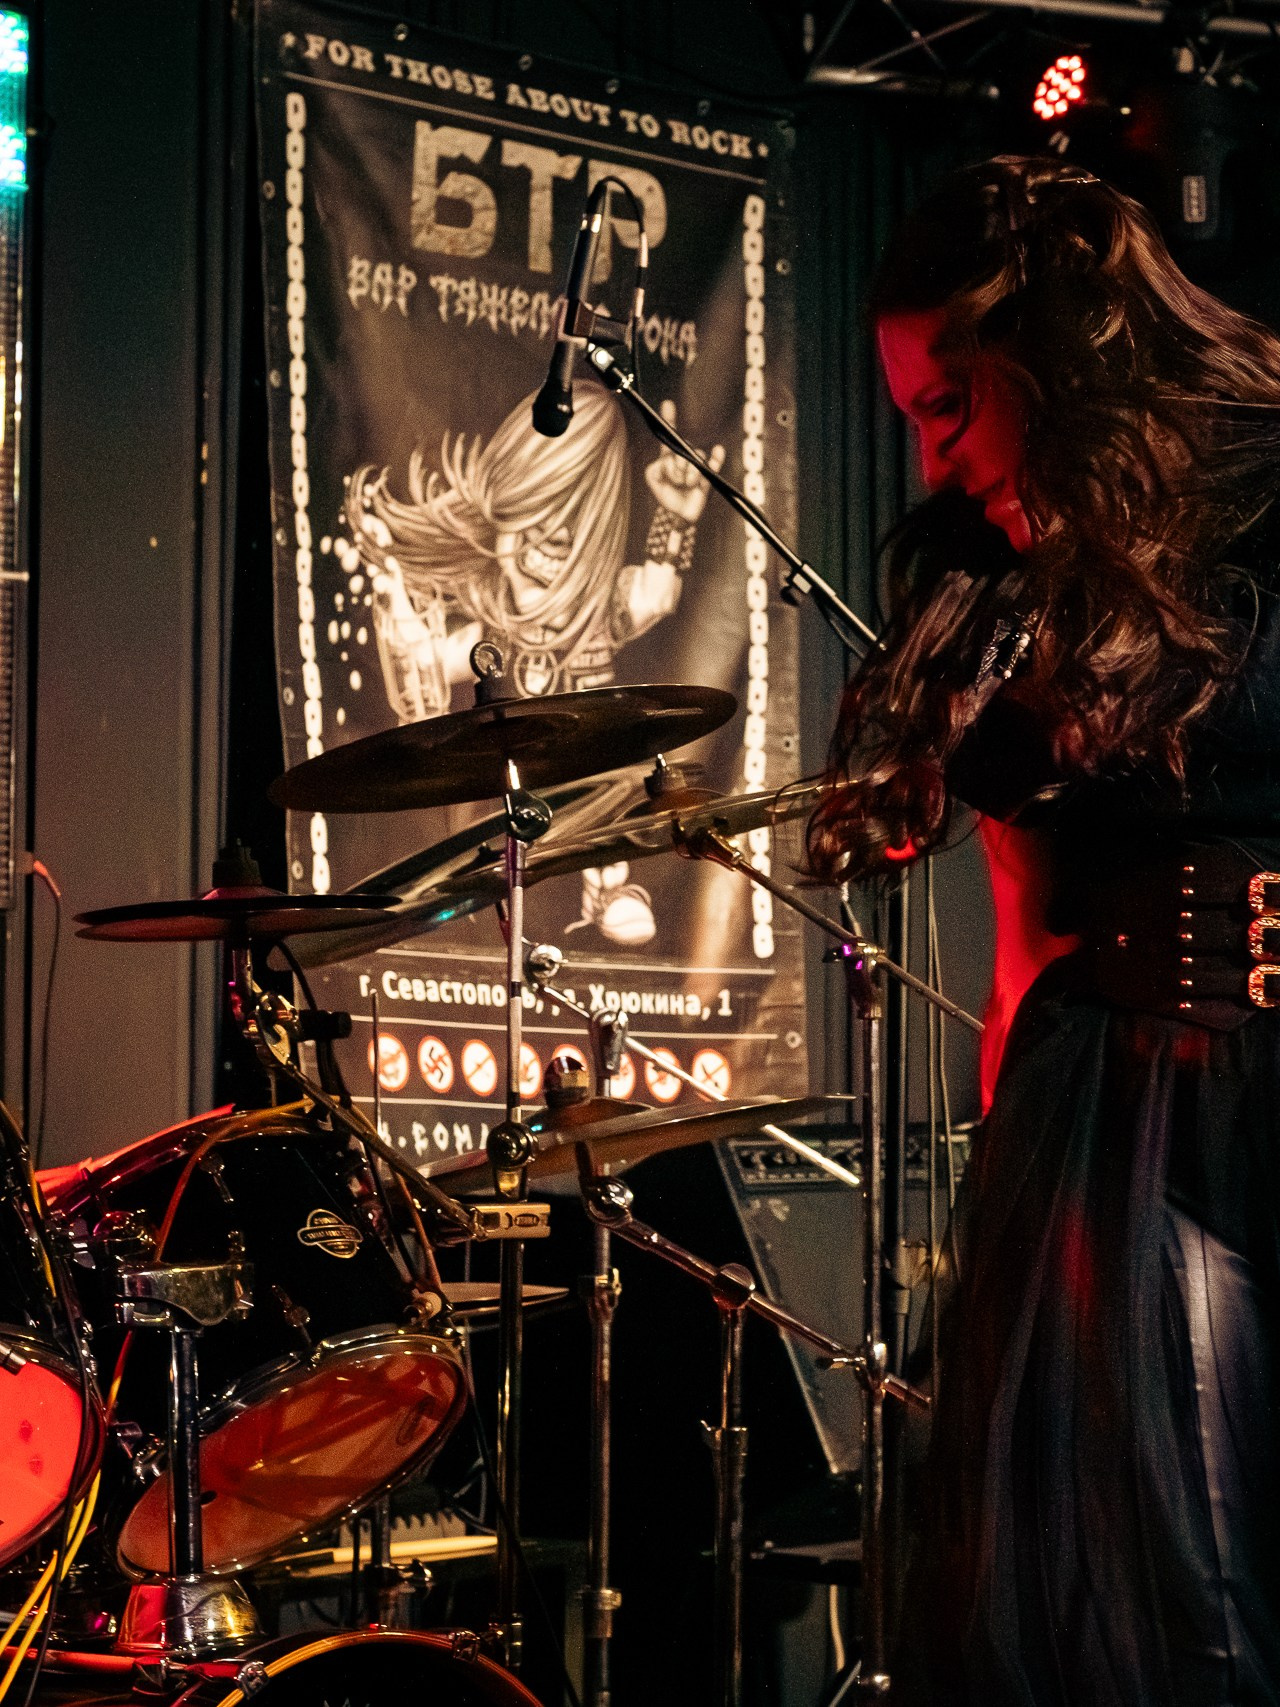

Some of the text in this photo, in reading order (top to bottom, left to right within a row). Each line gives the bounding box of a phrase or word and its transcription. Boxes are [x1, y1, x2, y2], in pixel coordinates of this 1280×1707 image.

[303, 33, 752, 159] FOR THOSE ABOUT TO ROCK
[410, 119, 667, 285] БТР
[381, 970, 545, 1015] Севастопоь,
[589, 983, 711, 1022] Хрюкина,
[717, 988, 733, 1017] 1
